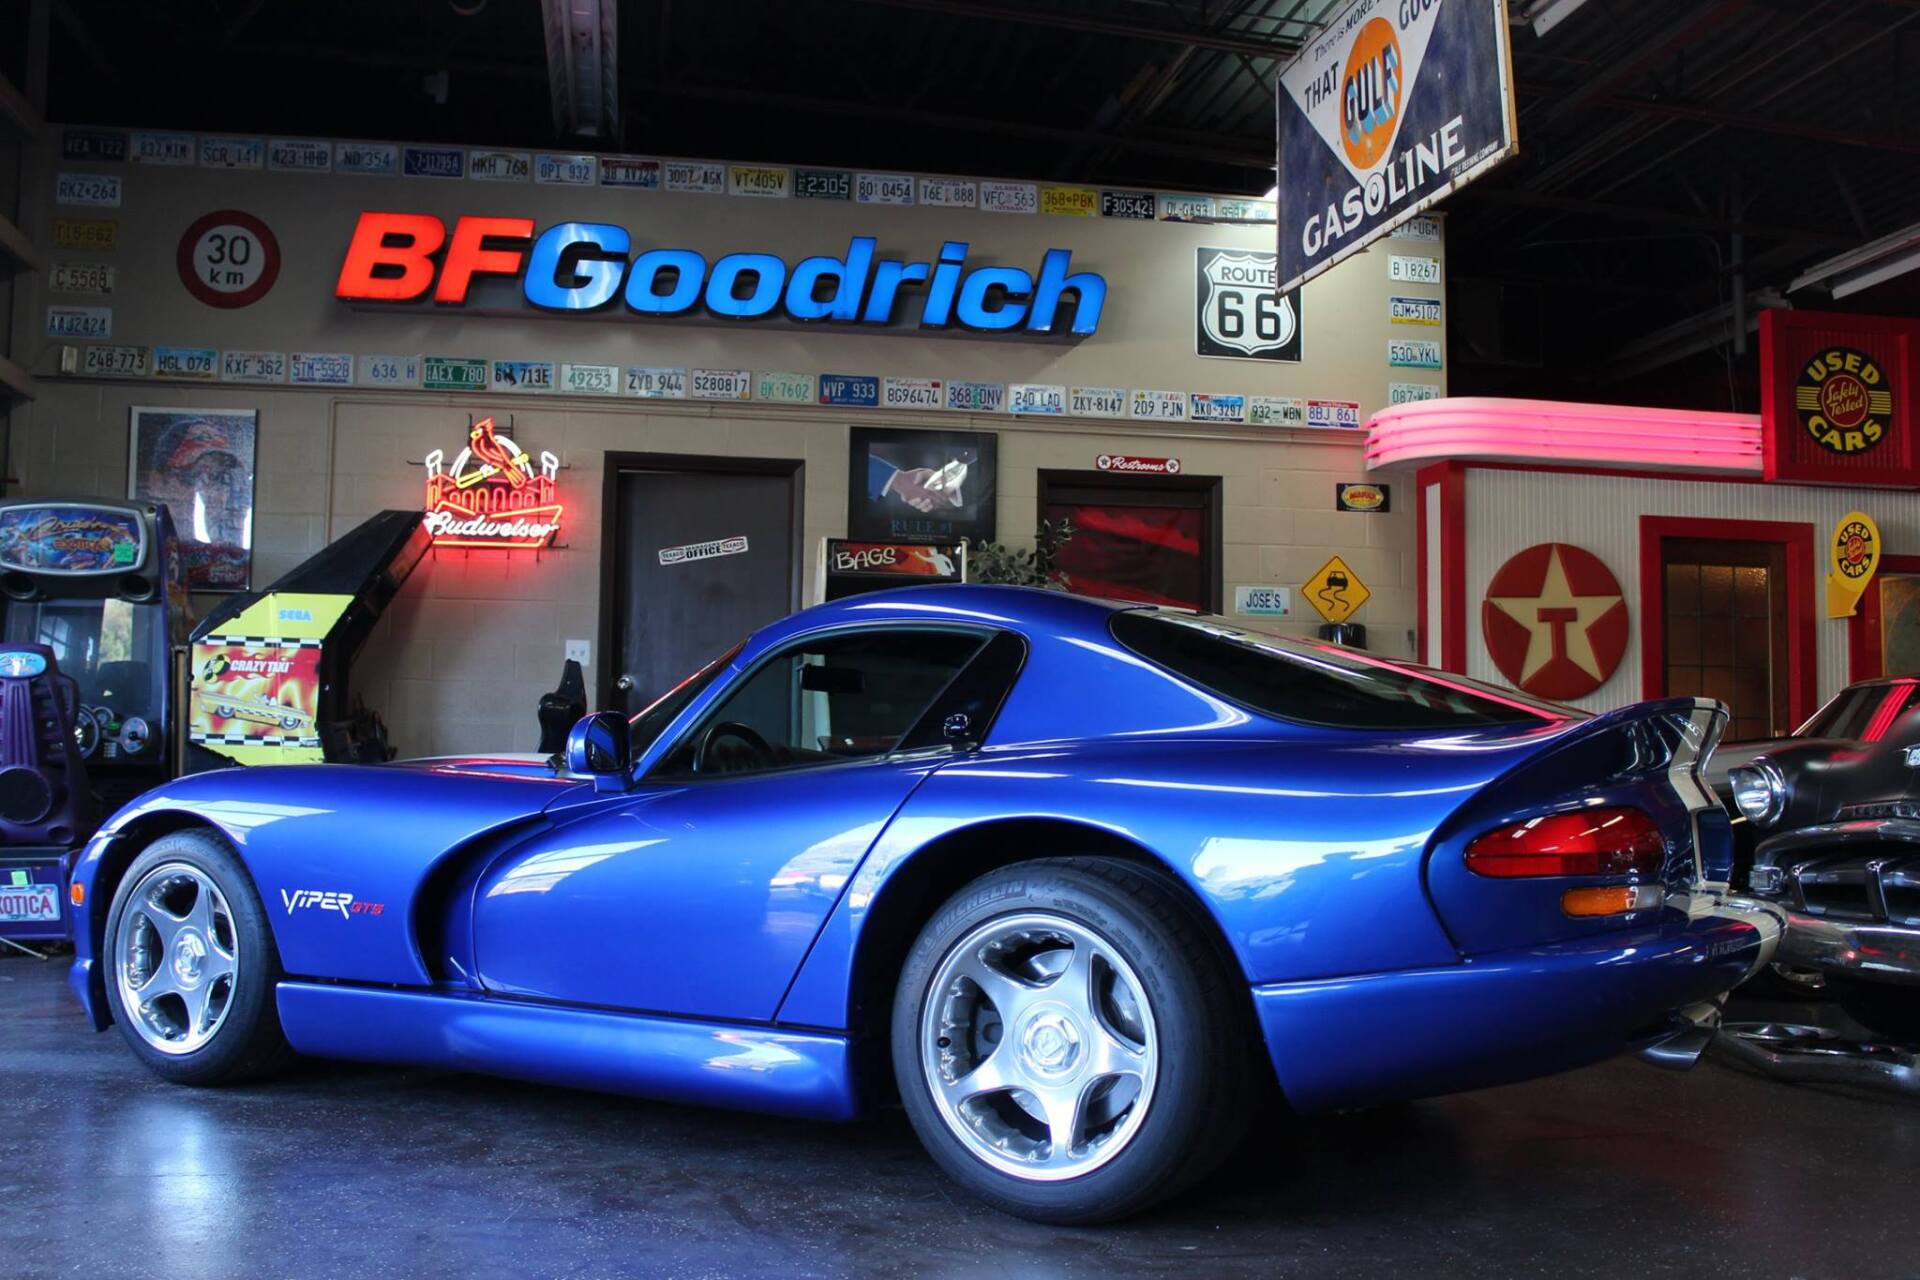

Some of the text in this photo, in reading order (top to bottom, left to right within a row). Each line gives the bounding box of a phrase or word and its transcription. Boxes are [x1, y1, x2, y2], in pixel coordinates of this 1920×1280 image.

[1345, 0, 1374, 33] MORE
[1304, 61, 1339, 113] THAT
[1344, 43, 1398, 142] GULF
[504, 160, 529, 177] 768
[1302, 115, 1466, 257] GASOLINE
[206, 233, 251, 266] 30
[334, 211, 1108, 337] BFGoodrich
[1221, 266, 1276, 284] ROUTE
[1217, 290, 1281, 341] 66
[371, 364, 398, 379] 636
[1807, 351, 1881, 385] USED
[1828, 394, 1863, 417] Tested
[1808, 414, 1883, 452] CARS
[1111, 456, 1165, 471] Restrooms
[423, 510, 560, 538] Budweiser
[891, 519, 933, 533] RULE
[1840, 523, 1869, 543] USED
[686, 546, 721, 559] OFFICE
[836, 547, 897, 570] BAGS
[1841, 556, 1870, 577] CARS
[1246, 592, 1281, 609] JOSE'S
[279, 608, 312, 621] SEGA
[230, 660, 267, 672] CRAZY
